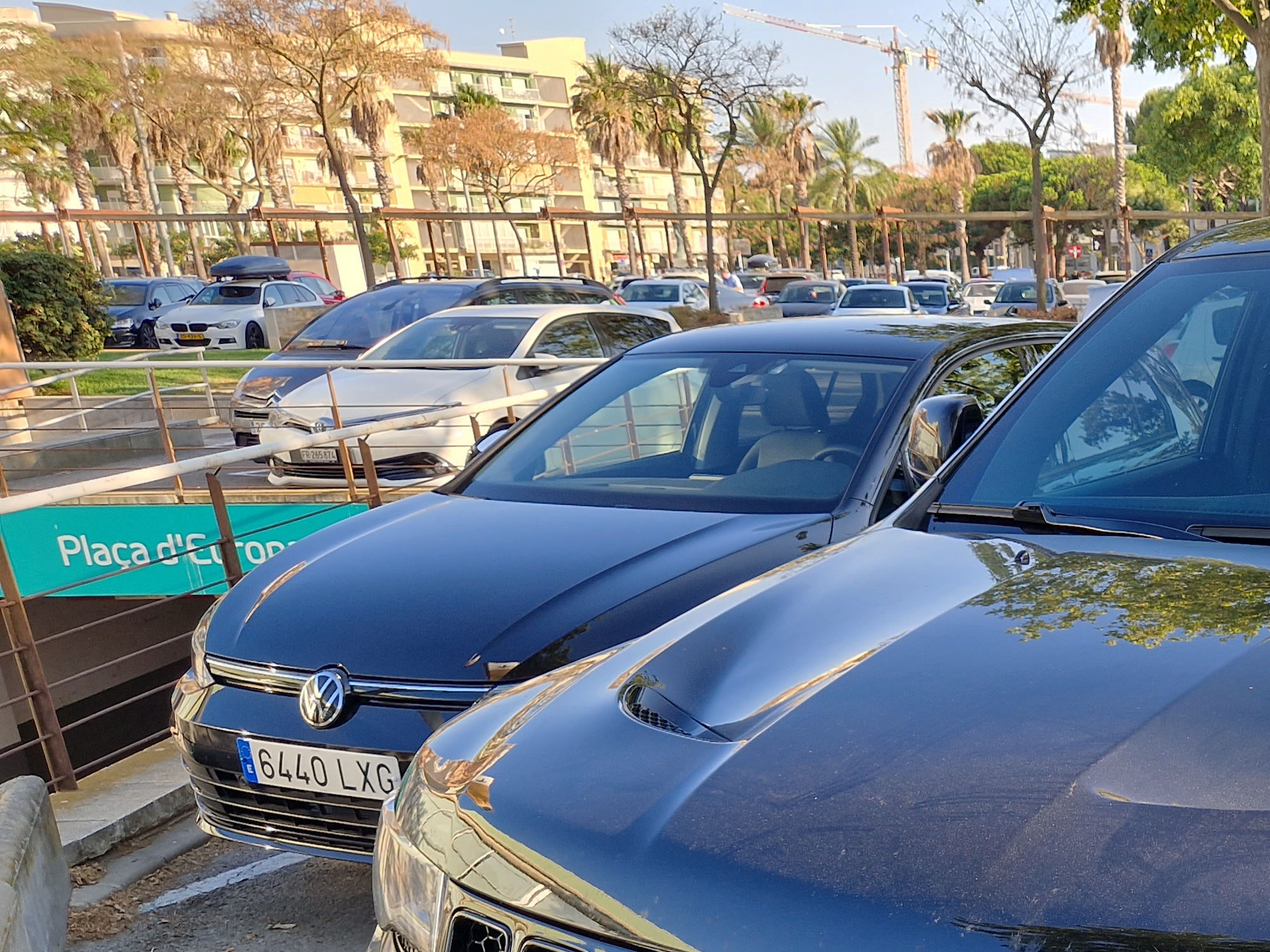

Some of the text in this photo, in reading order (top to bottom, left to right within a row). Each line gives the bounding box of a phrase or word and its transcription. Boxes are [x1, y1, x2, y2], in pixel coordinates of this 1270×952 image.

[56, 533, 151, 570] Plaça
[246, 748, 395, 795] E 6440 LXG
